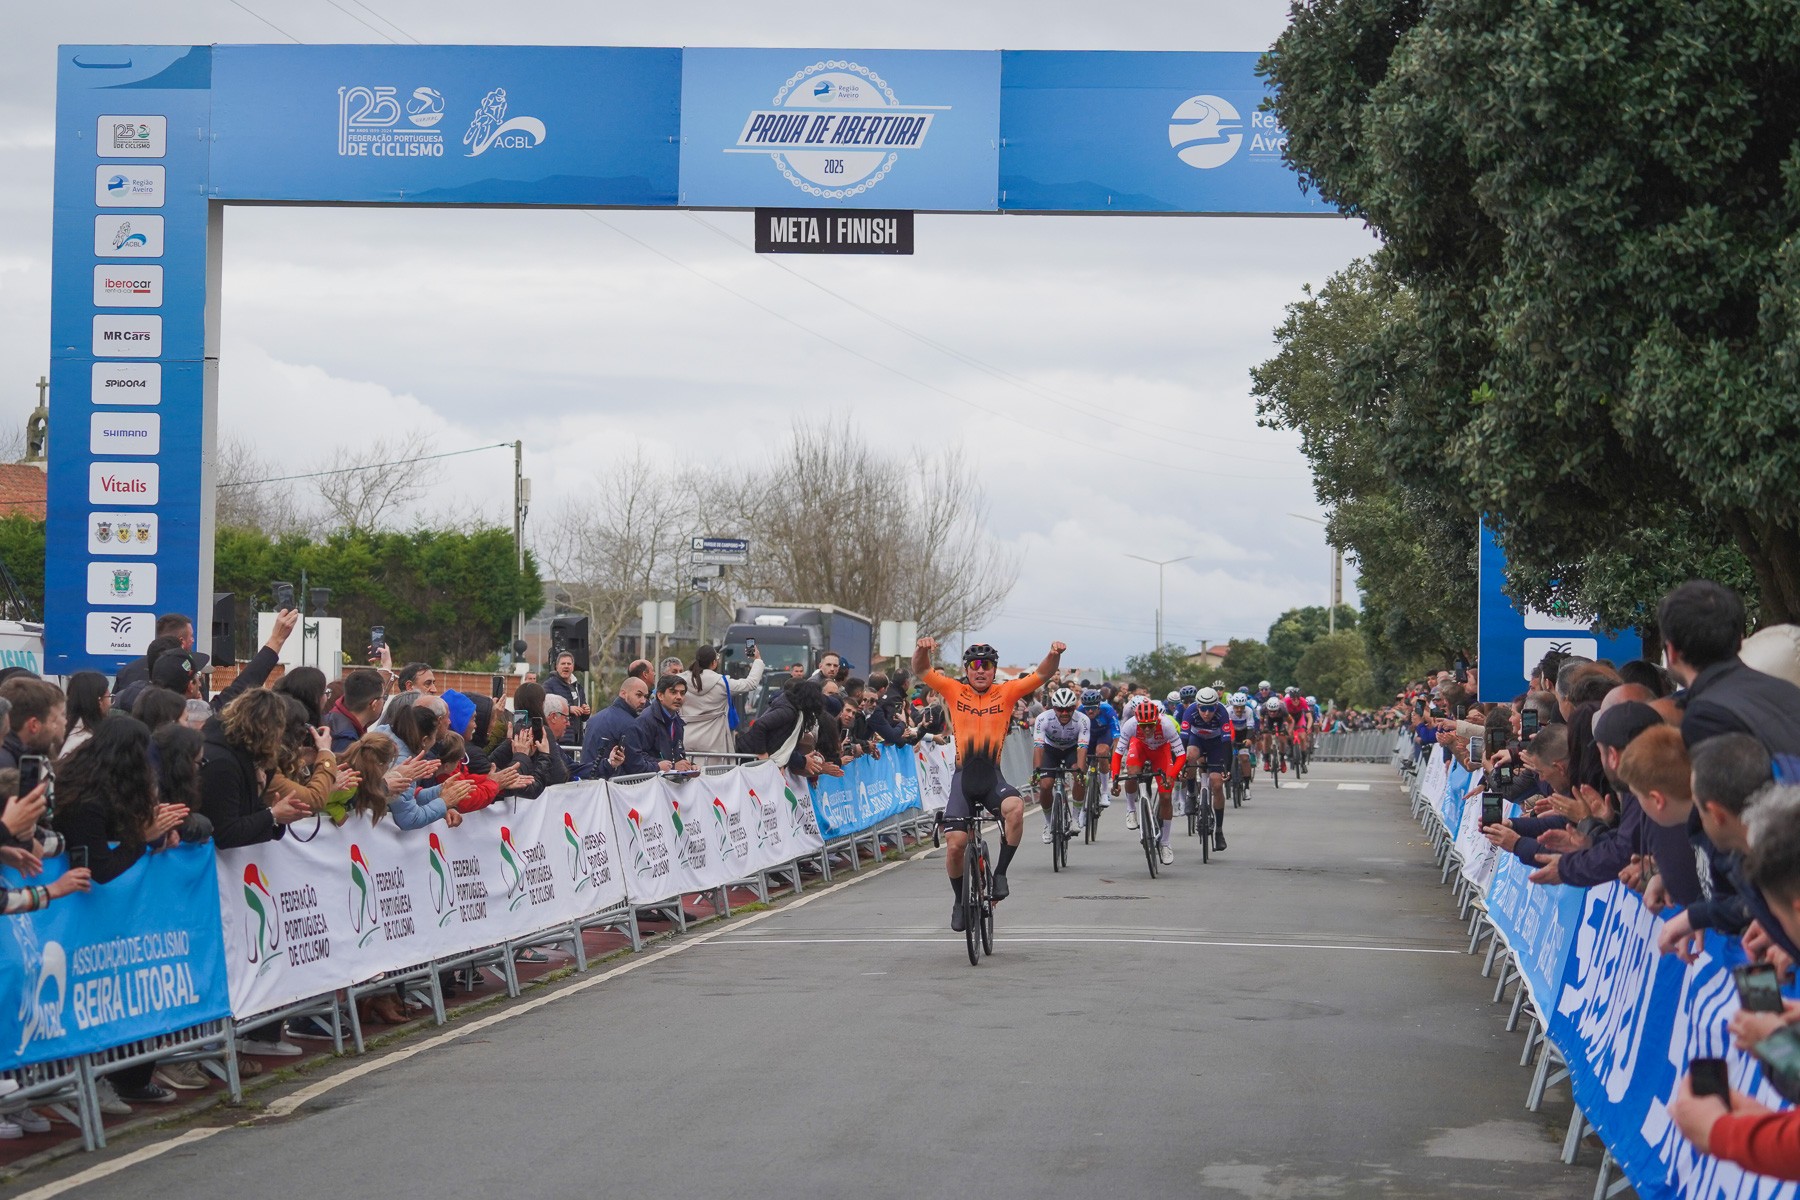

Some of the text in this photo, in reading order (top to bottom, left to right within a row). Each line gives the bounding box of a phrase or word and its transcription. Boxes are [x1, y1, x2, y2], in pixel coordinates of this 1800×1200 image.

[348, 134, 443, 144] FEDERAÇÃO PORTUGUESA
[745, 114, 926, 146] PROVA DE ABERTURA
[348, 142, 444, 157] DE CICLISMO
[493, 136, 533, 149] ACBL
[824, 159, 844, 174] 2025
[132, 179, 153, 187] Região
[770, 216, 820, 243] META
[837, 217, 897, 244] FINISH
[105, 278, 151, 289] iberocar
[103, 331, 151, 341] MR Cars
[103, 429, 148, 438] SHIMANO
[101, 475, 147, 493] Vitalis
[957, 700, 1004, 717] EFAPEL
[452, 855, 481, 881] FEDERAÇÃO
[376, 866, 405, 894] FEDERAÇÃO
[280, 883, 318, 914] FEDERAÇÃO
[456, 881, 489, 902] PORTUGUESA
[380, 893, 413, 918] PORTUGUESA
[459, 901, 487, 923] DE CICLISMO
[284, 913, 329, 942] PORTUGUESA
[383, 916, 415, 941] DE CICLISMO
[71, 930, 190, 976] ASSOCIAÇÃO DE CICLISMO
[288, 937, 330, 968] DE CICLISMO
[73, 961, 200, 1032] BEIRA LITORAL
